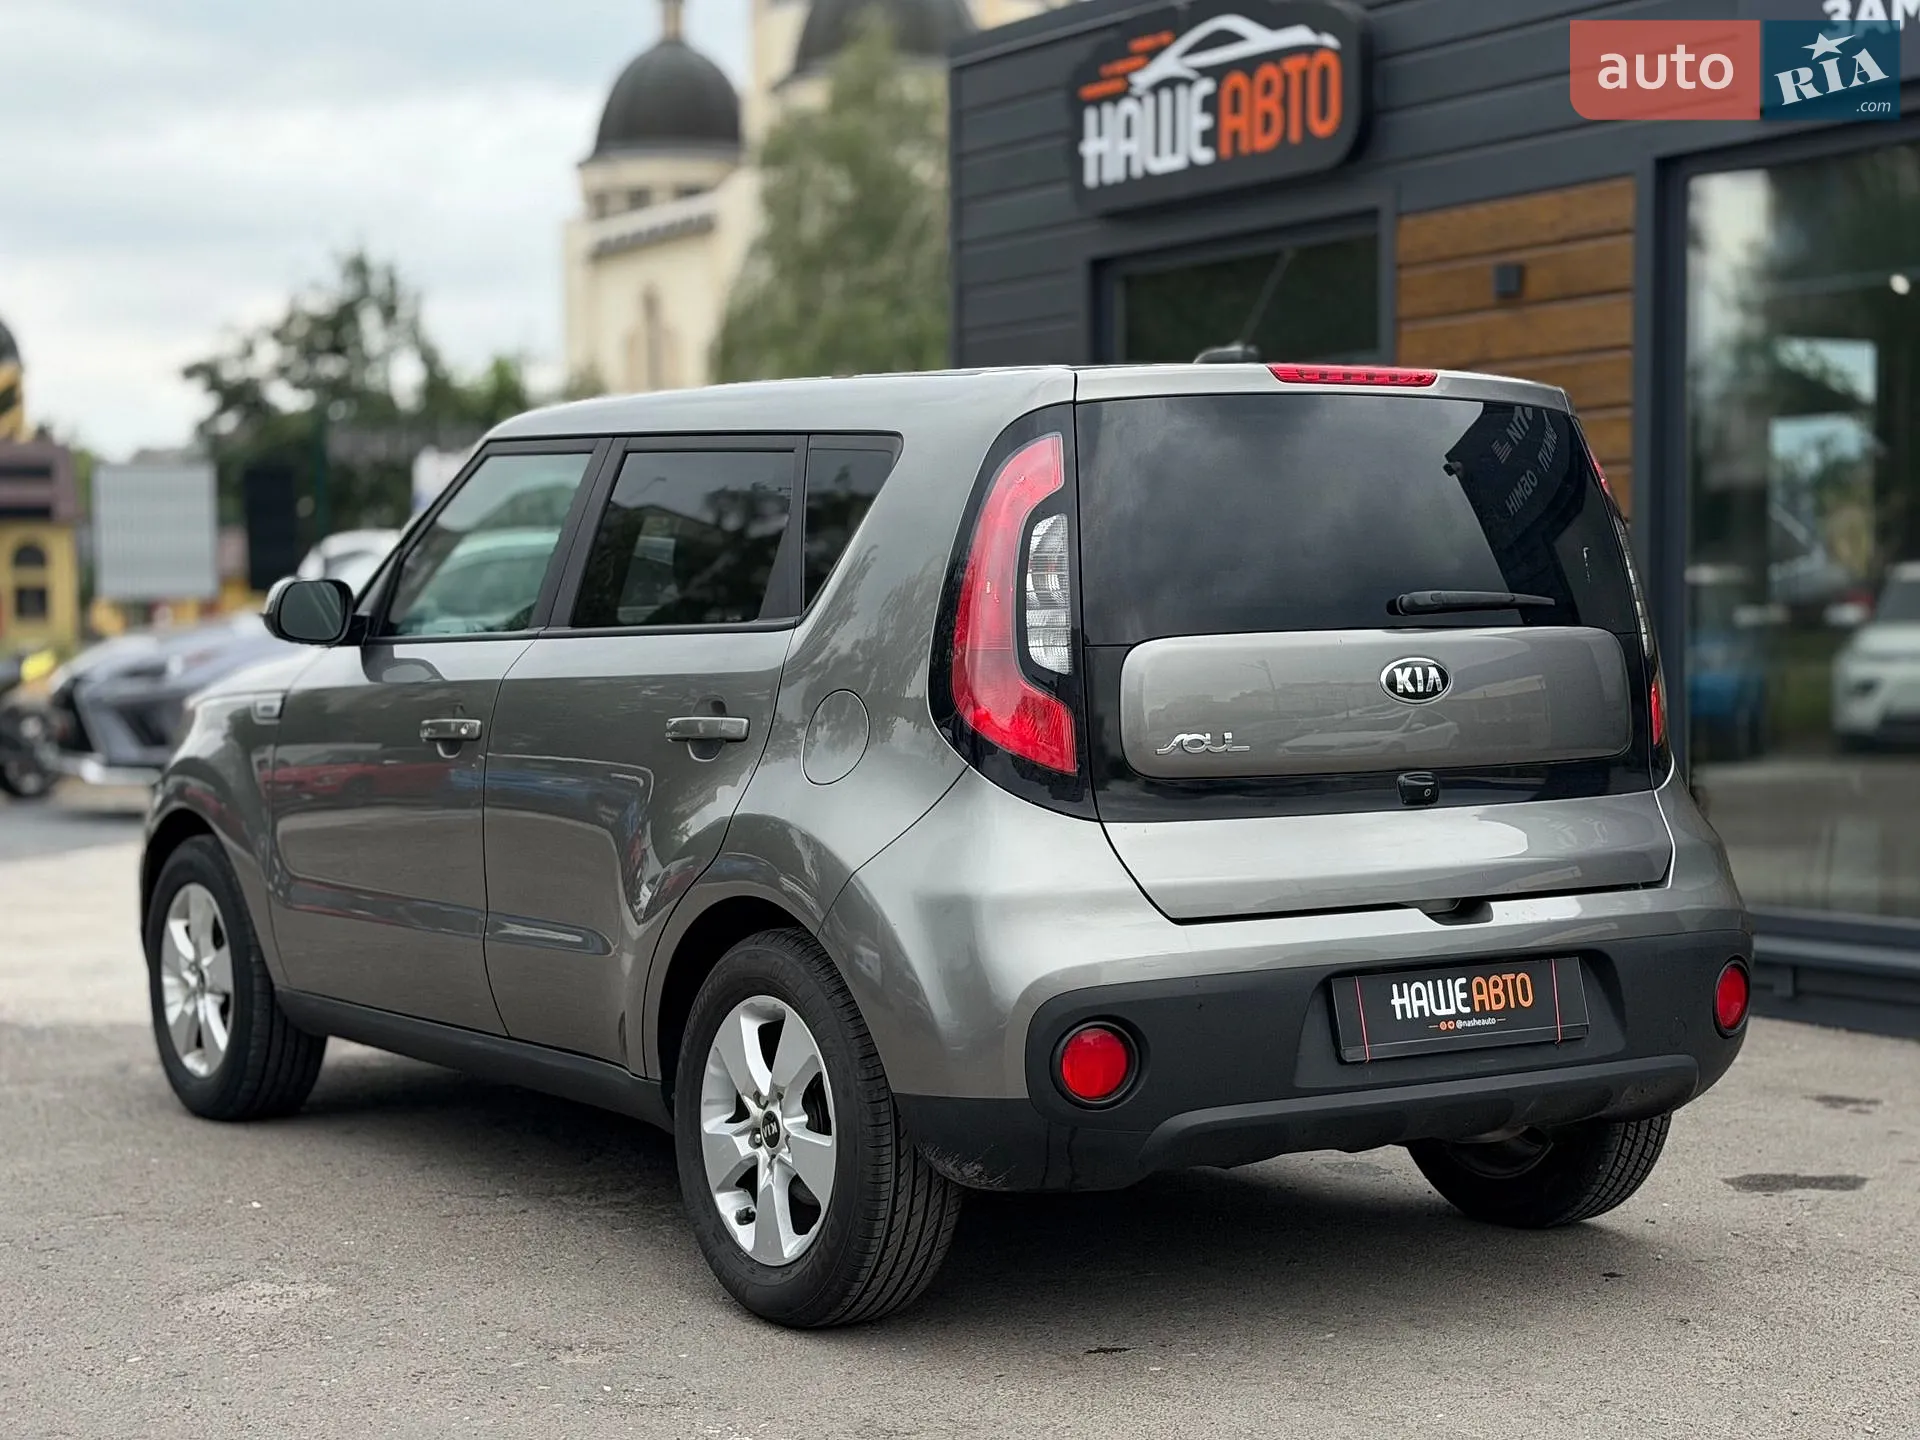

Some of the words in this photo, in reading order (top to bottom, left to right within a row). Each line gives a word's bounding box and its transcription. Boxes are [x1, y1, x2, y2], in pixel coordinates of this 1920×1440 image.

[1079, 76, 1217, 189] НАШЕ
[1218, 48, 1342, 159] АВТО
[1393, 667, 1443, 694] KIA
[1156, 732, 1250, 755] SOUL
[1391, 976, 1471, 1020] НАШЕ
[1471, 972, 1533, 1012] АВТО
[1456, 1017, 1497, 1029] @nasheauto
